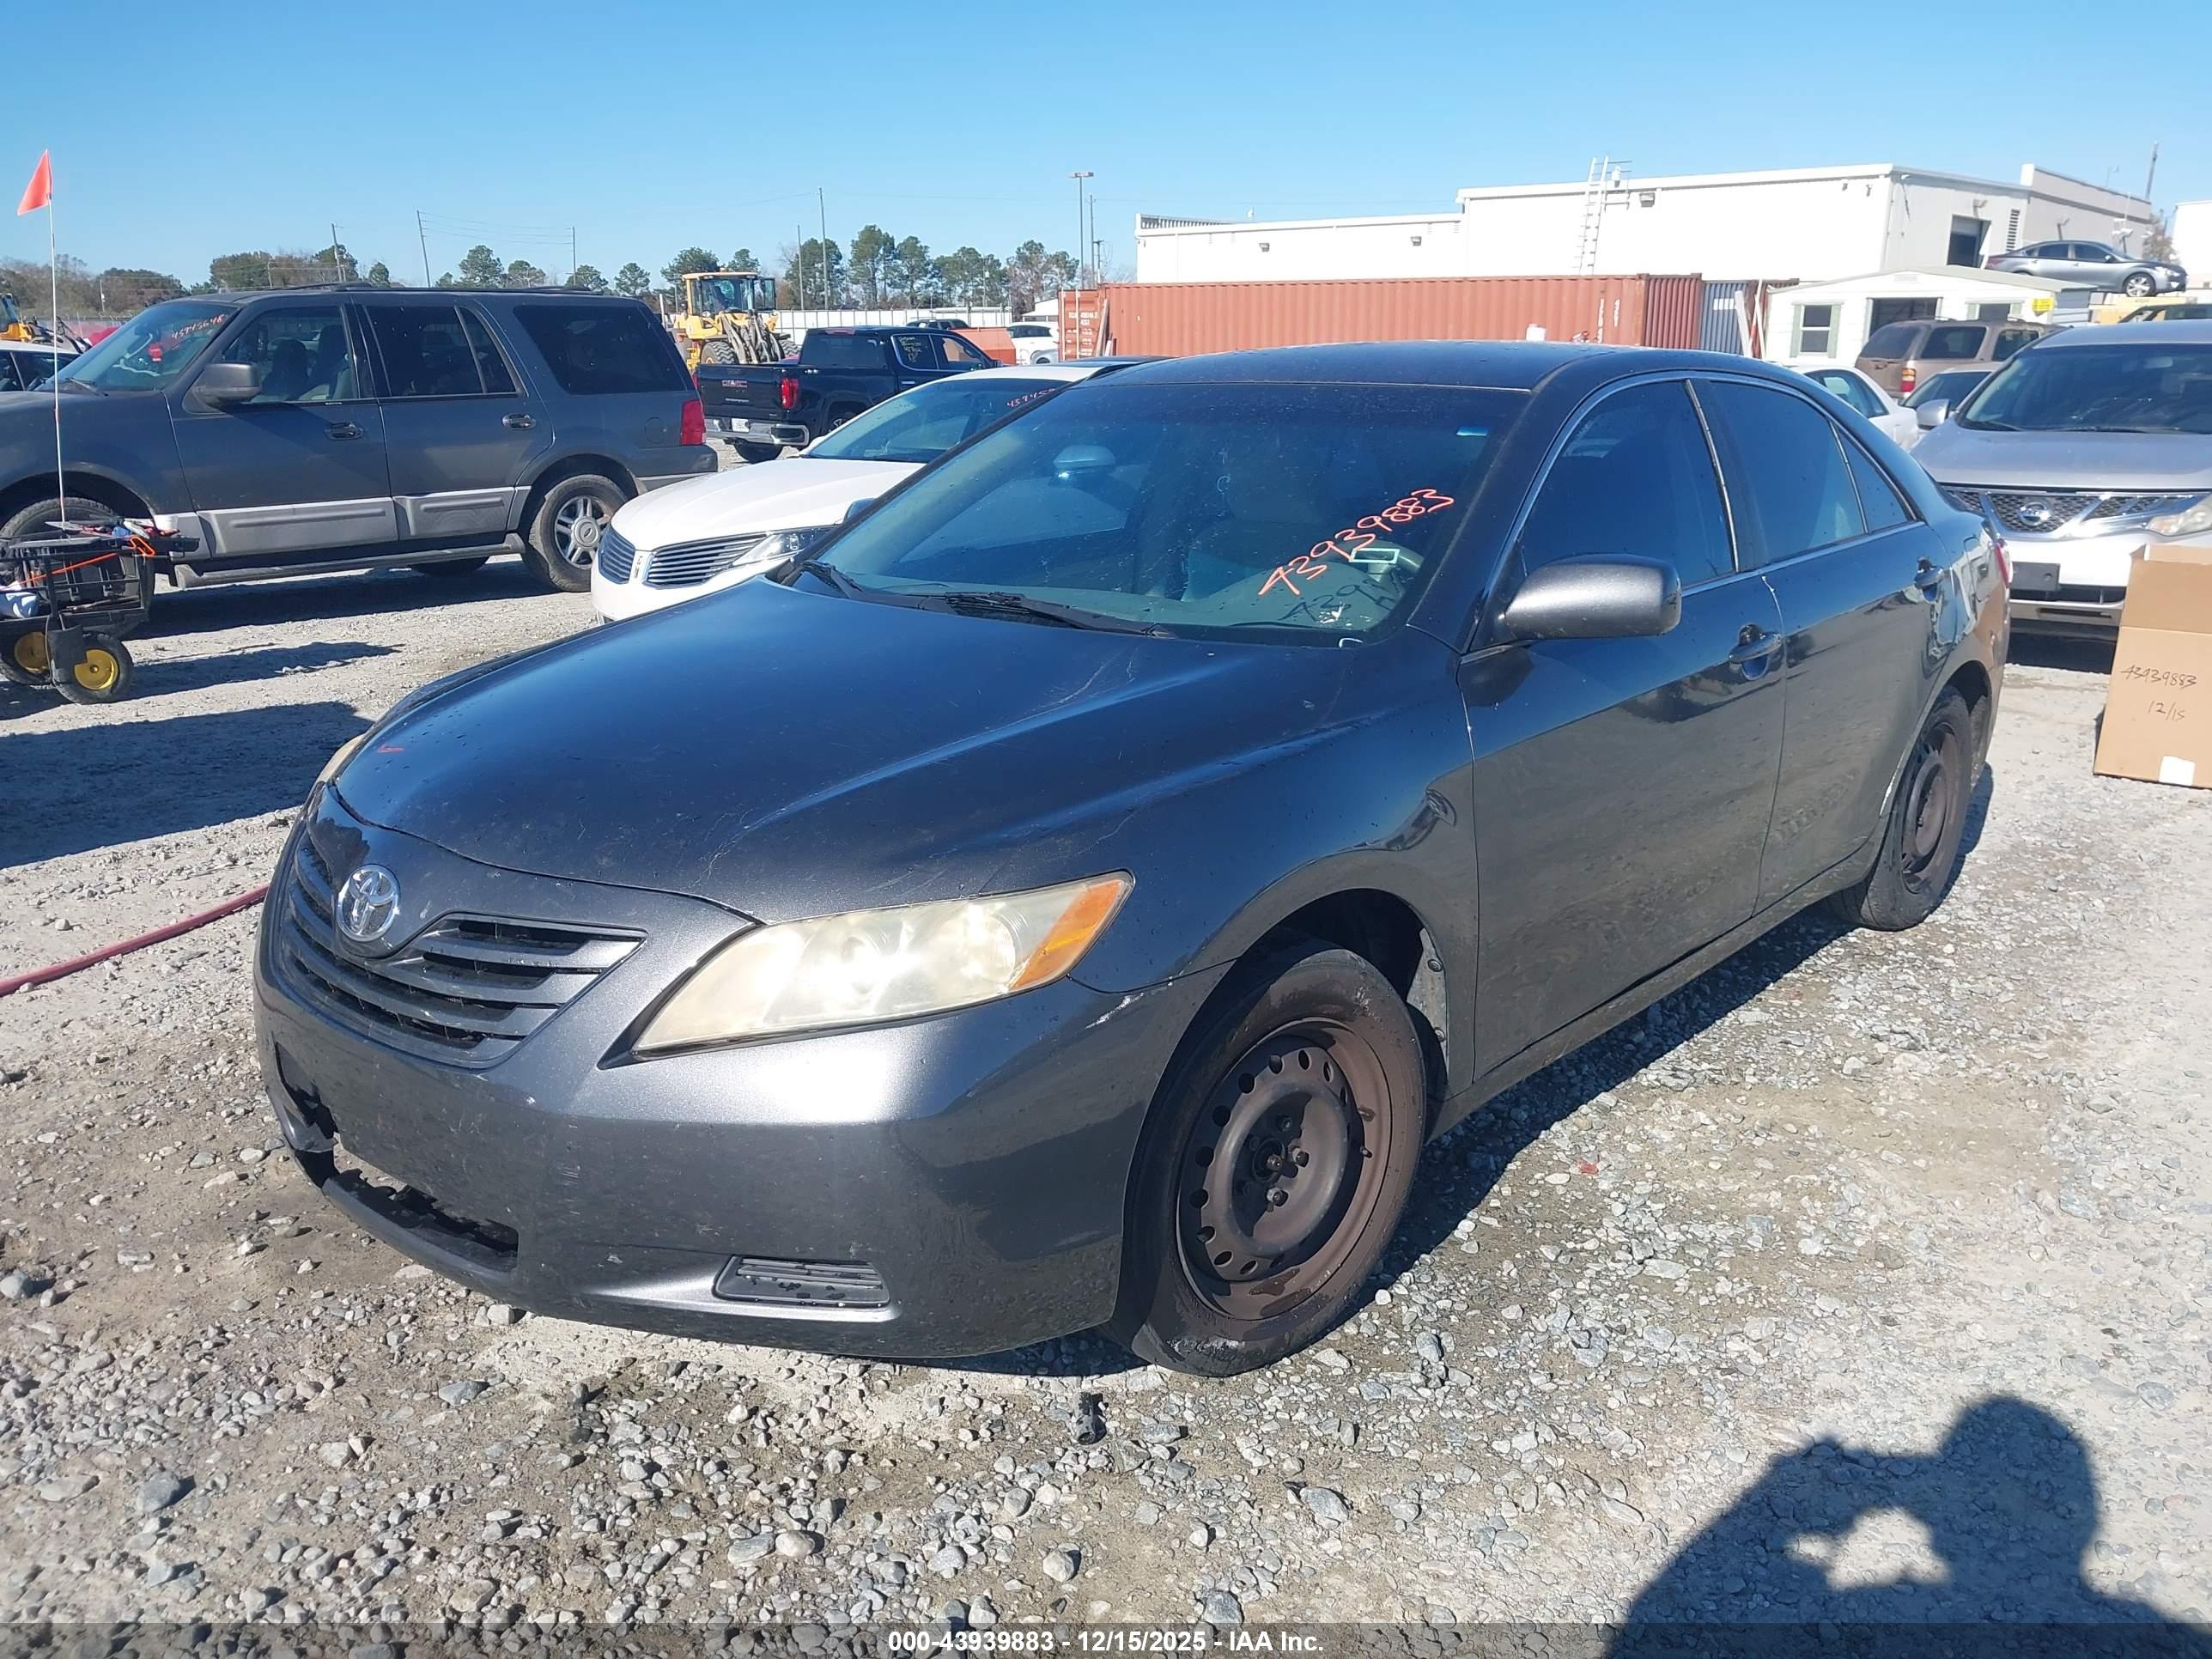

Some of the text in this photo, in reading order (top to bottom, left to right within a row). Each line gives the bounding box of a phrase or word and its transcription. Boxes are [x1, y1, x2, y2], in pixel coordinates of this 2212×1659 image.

[1258, 489, 1455, 595] 43939883
[2120, 665, 2197, 690] 43939883
[2148, 700, 2185, 721] 12/15
